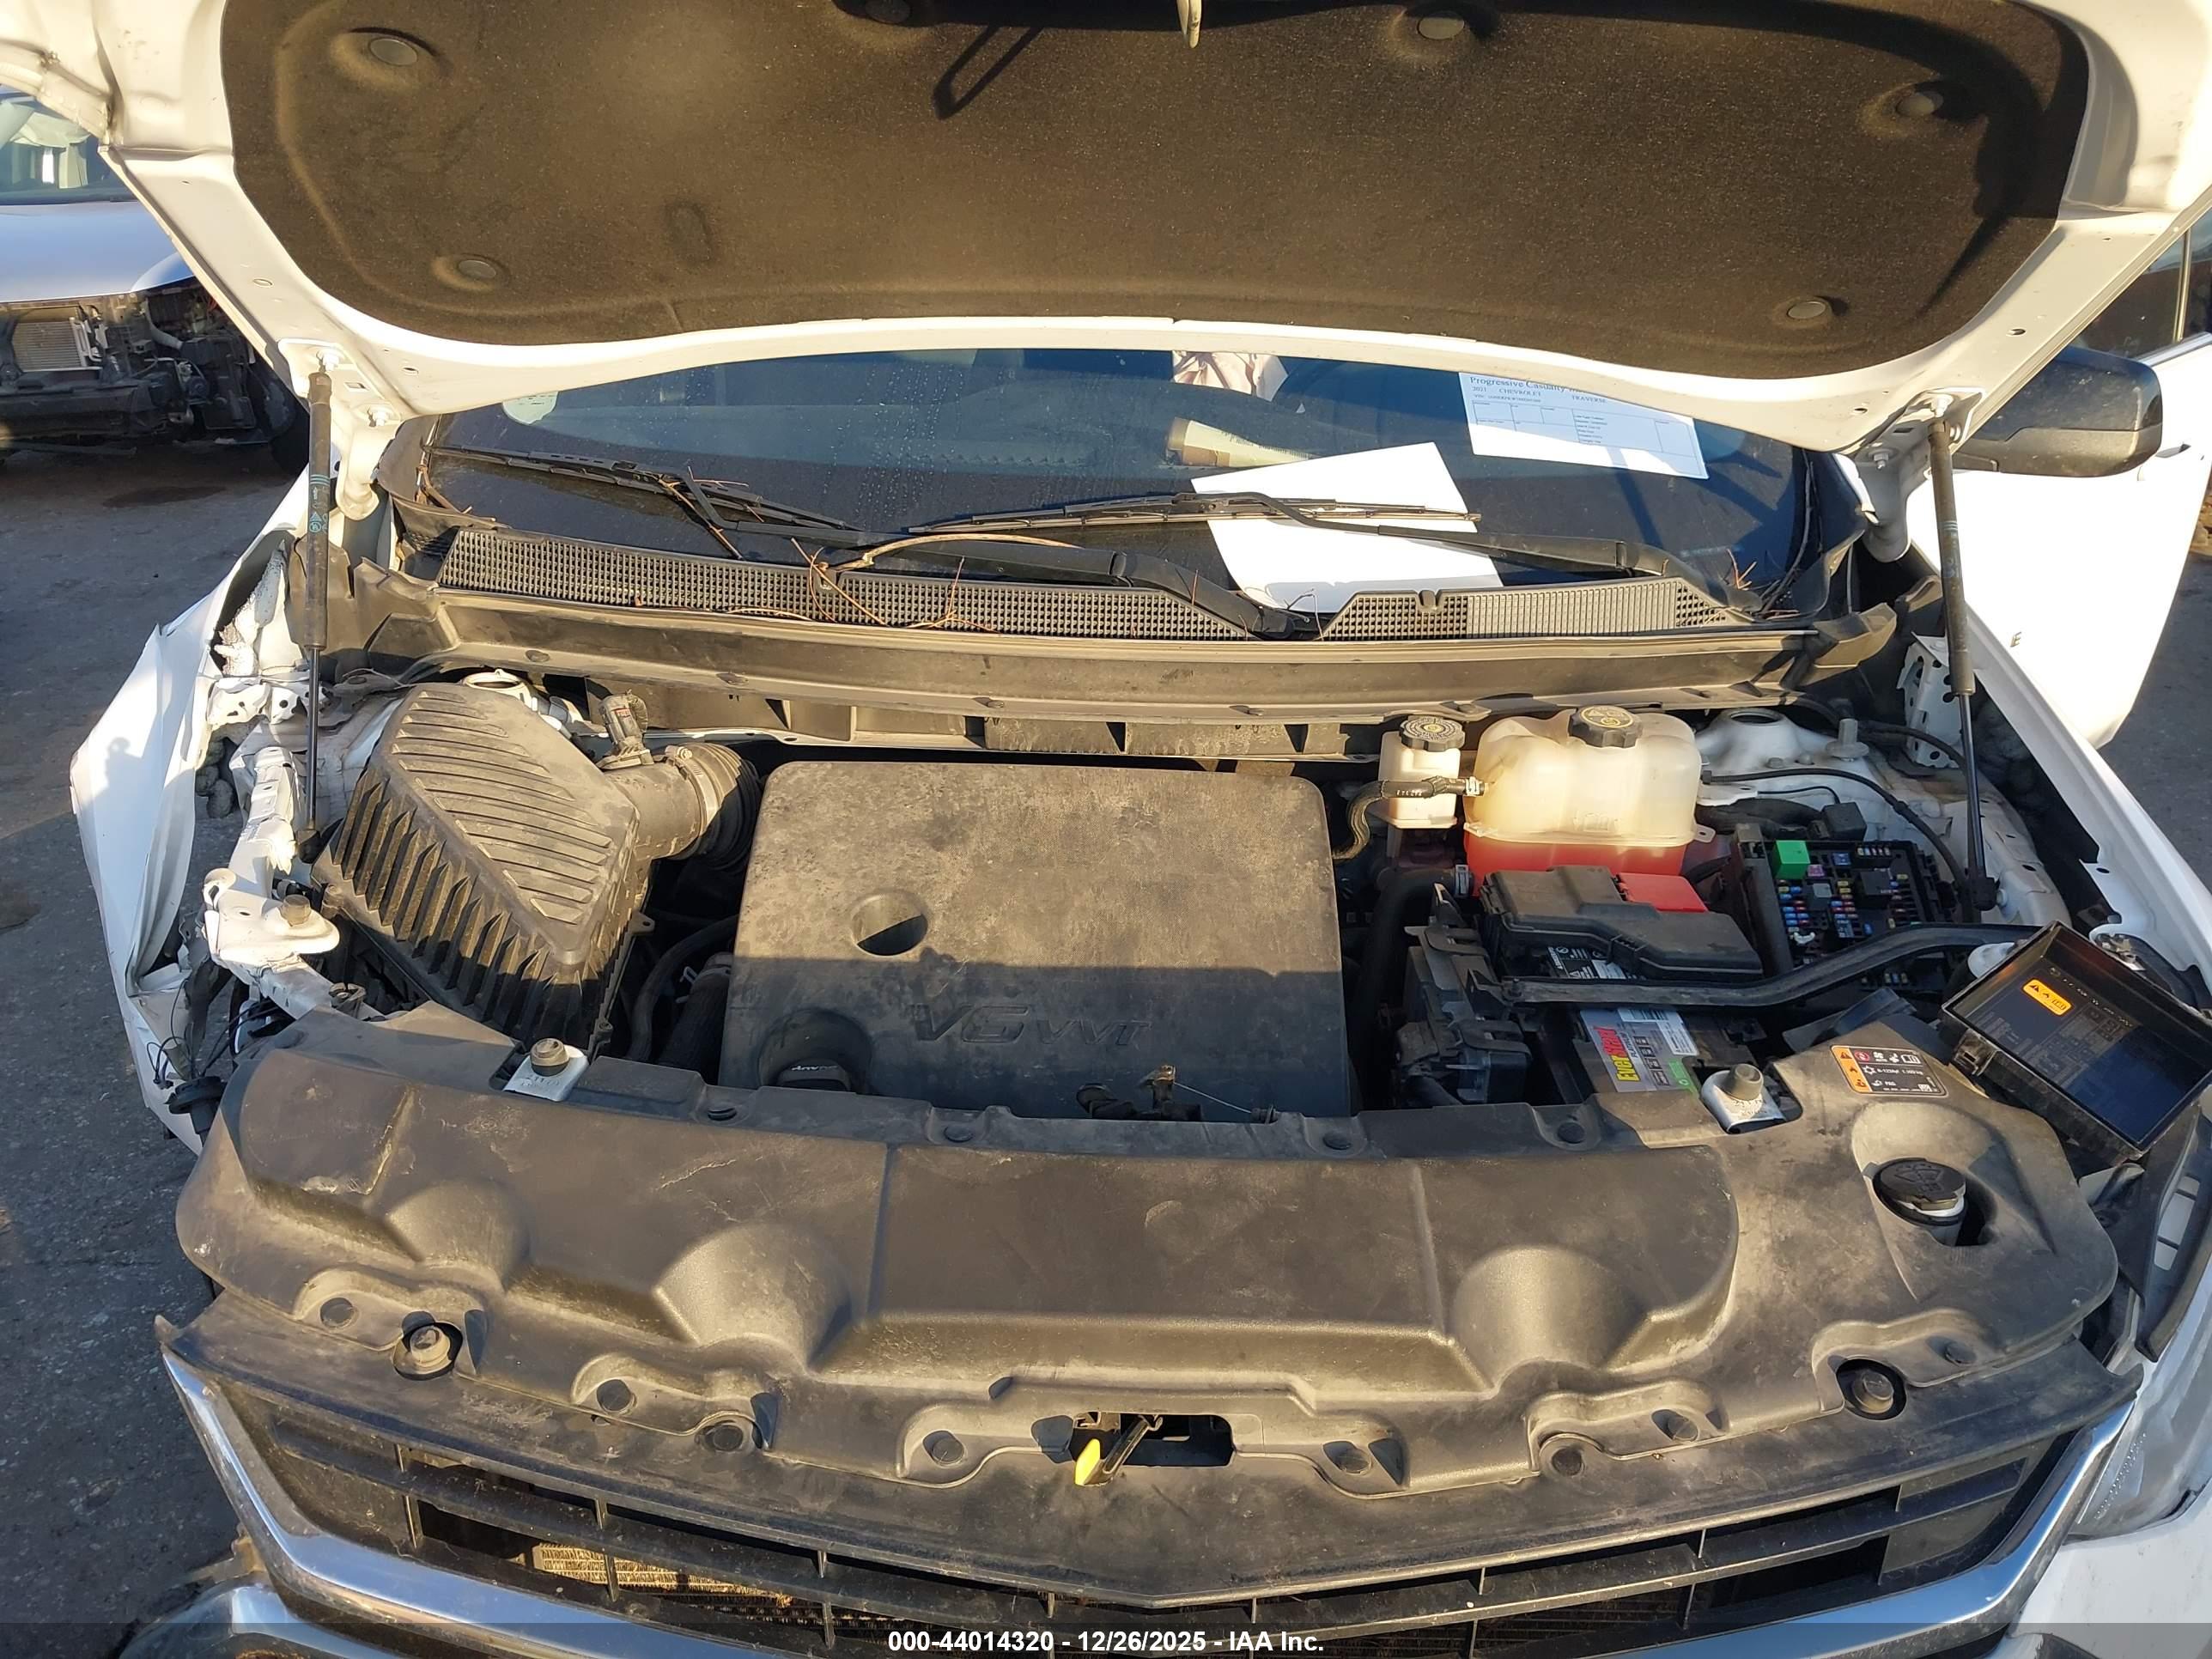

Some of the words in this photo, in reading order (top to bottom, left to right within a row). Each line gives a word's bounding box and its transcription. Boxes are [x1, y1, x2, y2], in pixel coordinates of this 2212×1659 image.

[1470, 376, 1523, 388] Progressive
[1499, 388, 1541, 398] CHEVROLET
[907, 1002, 1030, 1044] V6
[1036, 1018, 1153, 1045] VVT
